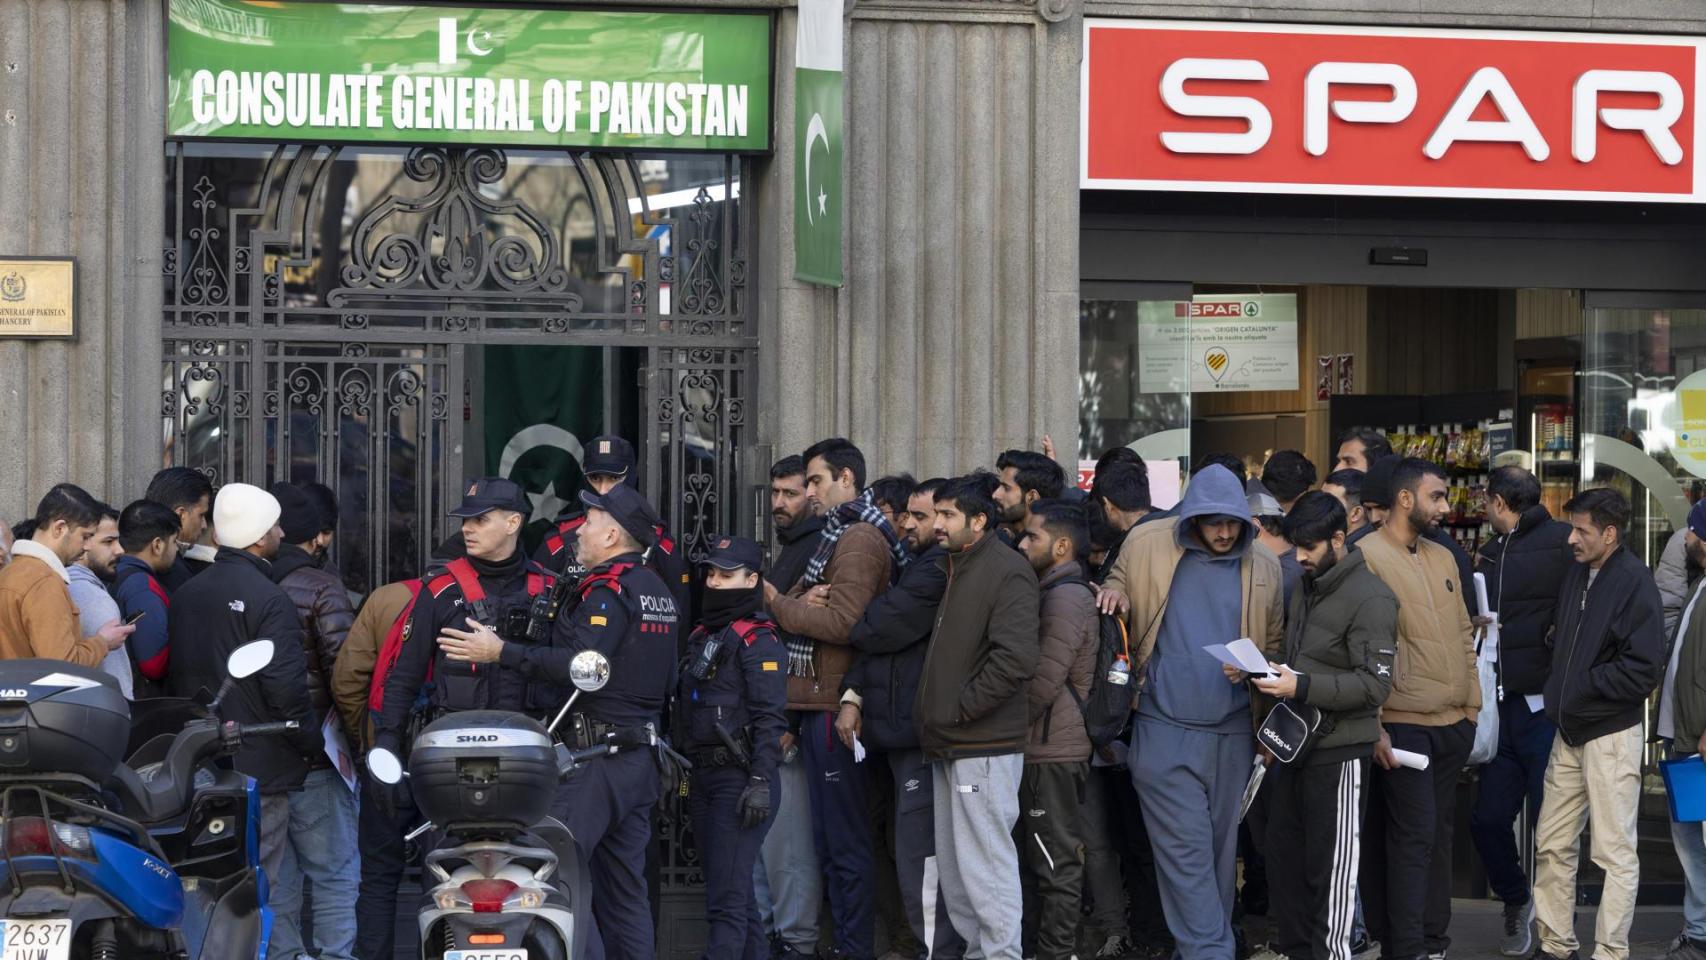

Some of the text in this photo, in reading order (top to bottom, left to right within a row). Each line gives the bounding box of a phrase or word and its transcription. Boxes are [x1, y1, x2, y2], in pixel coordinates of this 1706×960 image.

[192, 69, 748, 137] CONSULATE GENERAL OF PAKISTAN
[1159, 57, 1685, 166] SPAR
[36, 308, 66, 317] PAKISTAN
[1191, 304, 1240, 316] SPAR
[0, 317, 31, 325] HANCERY
[0, 688, 28, 698] HAD
[456, 734, 498, 743] SHAD
[1263, 727, 1285, 748] adidas
[8, 924, 68, 946] 2637
